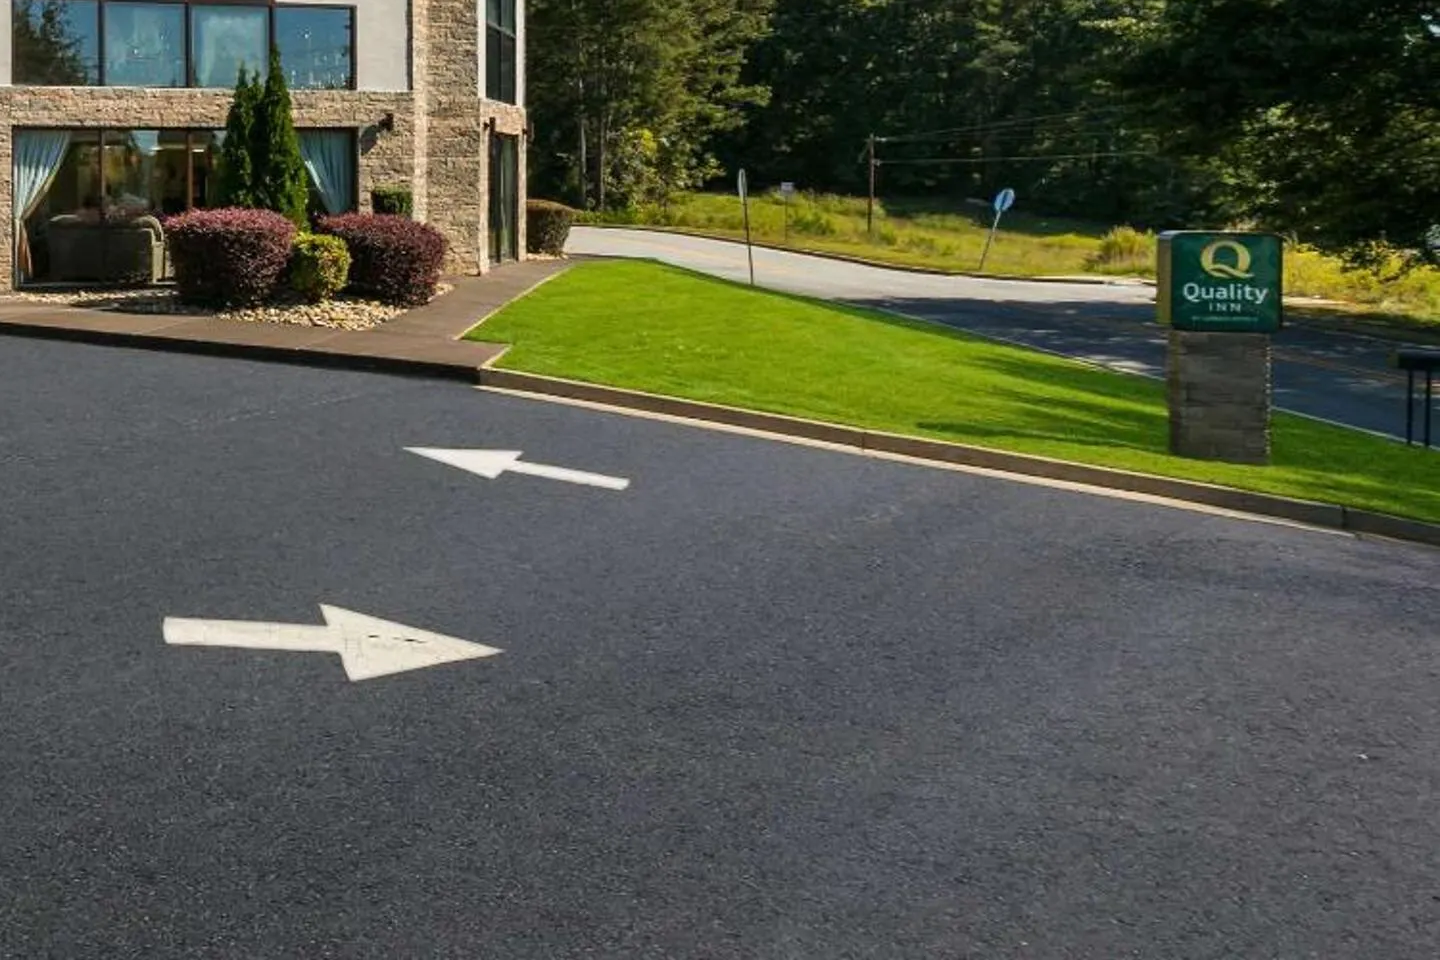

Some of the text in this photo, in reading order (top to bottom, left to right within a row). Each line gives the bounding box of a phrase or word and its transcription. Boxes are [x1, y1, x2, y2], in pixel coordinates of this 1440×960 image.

[1200, 241, 1255, 279] Q
[1183, 282, 1269, 304] Quality
[1209, 302, 1242, 312] INN
